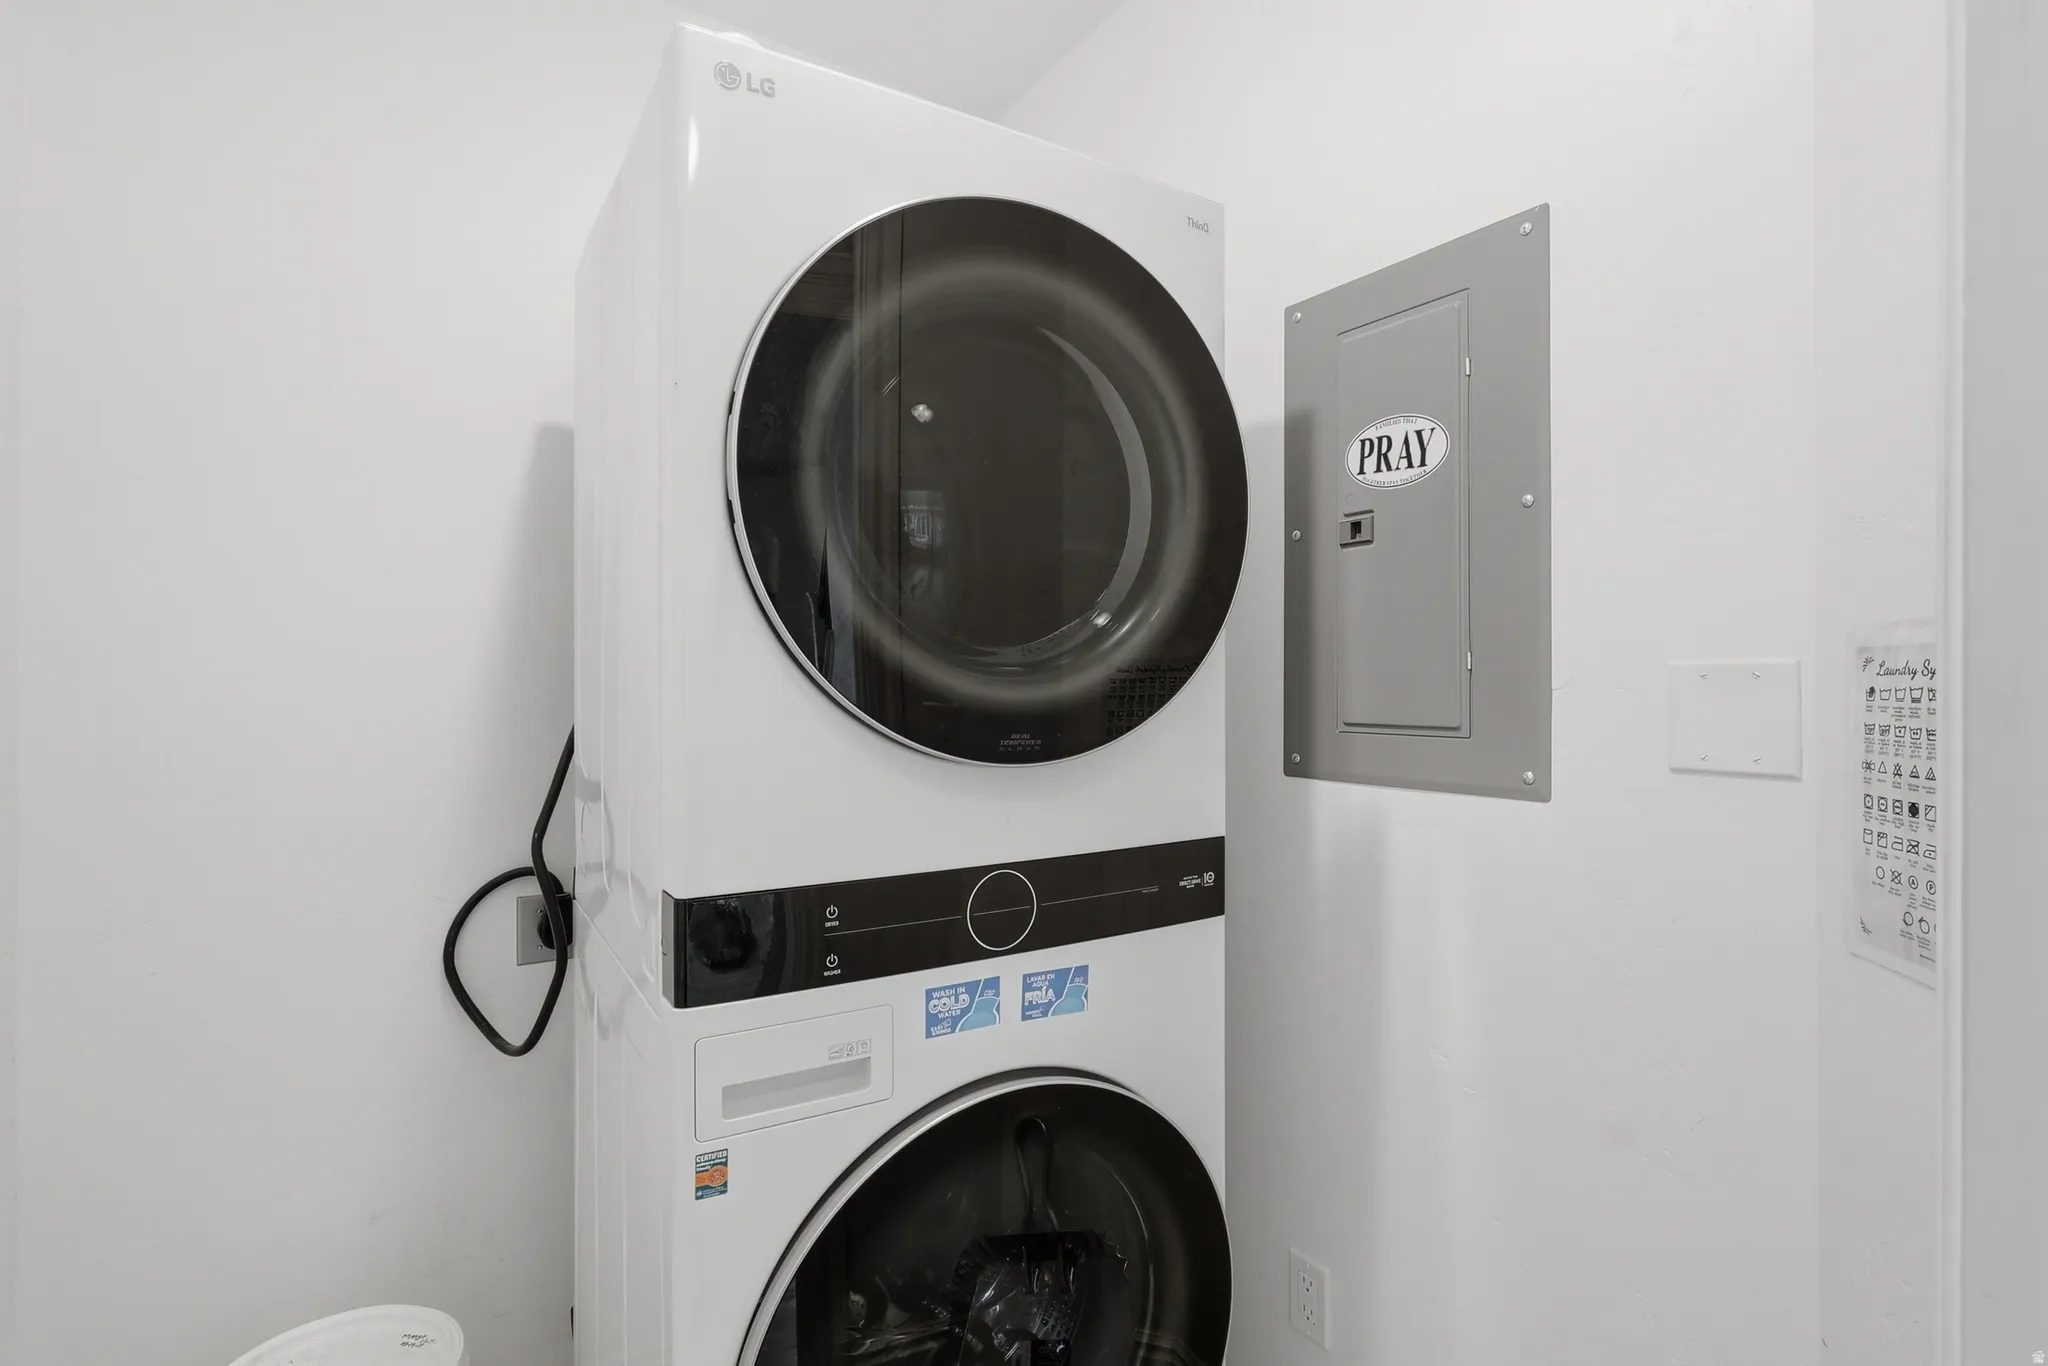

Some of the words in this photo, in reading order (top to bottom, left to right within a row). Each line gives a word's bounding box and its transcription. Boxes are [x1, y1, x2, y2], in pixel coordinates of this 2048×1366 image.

[747, 72, 776, 97] LG
[1186, 216, 1210, 233] ThinQ
[1356, 427, 1436, 476] PRAY
[1876, 660, 1918, 681] Laundry
[1026, 974, 1046, 983] LAVAR
[931, 988, 956, 999] WASH
[957, 986, 966, 994] IN
[1024, 986, 1056, 1006] FRÍA
[928, 993, 970, 1014] COLD
[938, 1010, 961, 1019] WATER
[696, 1150, 727, 1163] CERTIFIED
